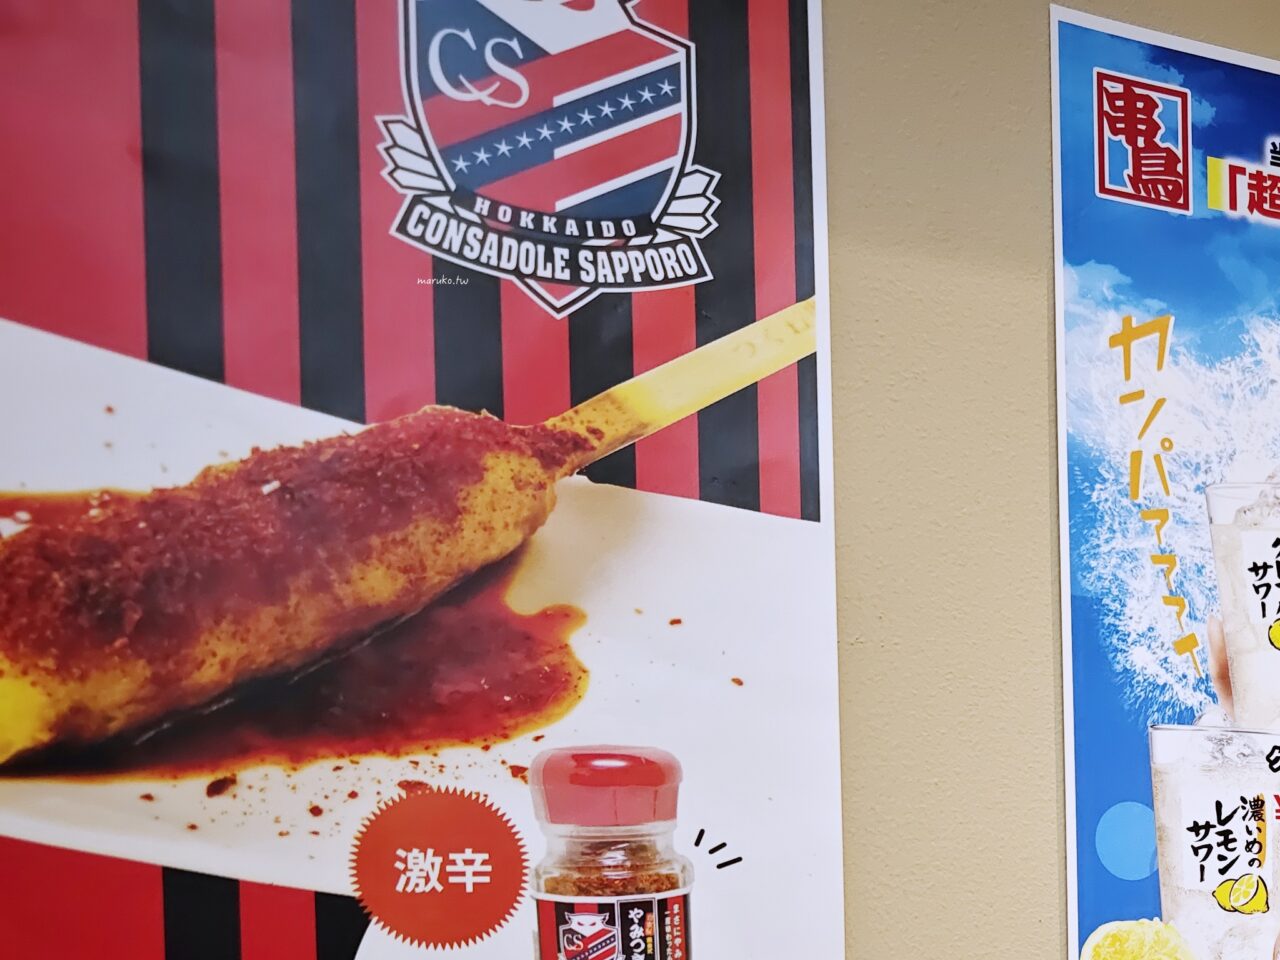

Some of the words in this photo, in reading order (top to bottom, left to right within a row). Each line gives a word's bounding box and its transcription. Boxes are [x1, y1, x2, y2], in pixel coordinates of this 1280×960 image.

[428, 28, 530, 109] CS
[406, 205, 570, 281] CONSADOLE
[578, 244, 699, 285] SAPPORO
[474, 196, 638, 239] HOKKAIDO
[1247, 561, 1274, 619] サワー
[1187, 821, 1215, 882] サワー
[1215, 800, 1240, 875] レモン
[1240, 796, 1264, 868] 濃いめの
[394, 848, 493, 894] 激辛
